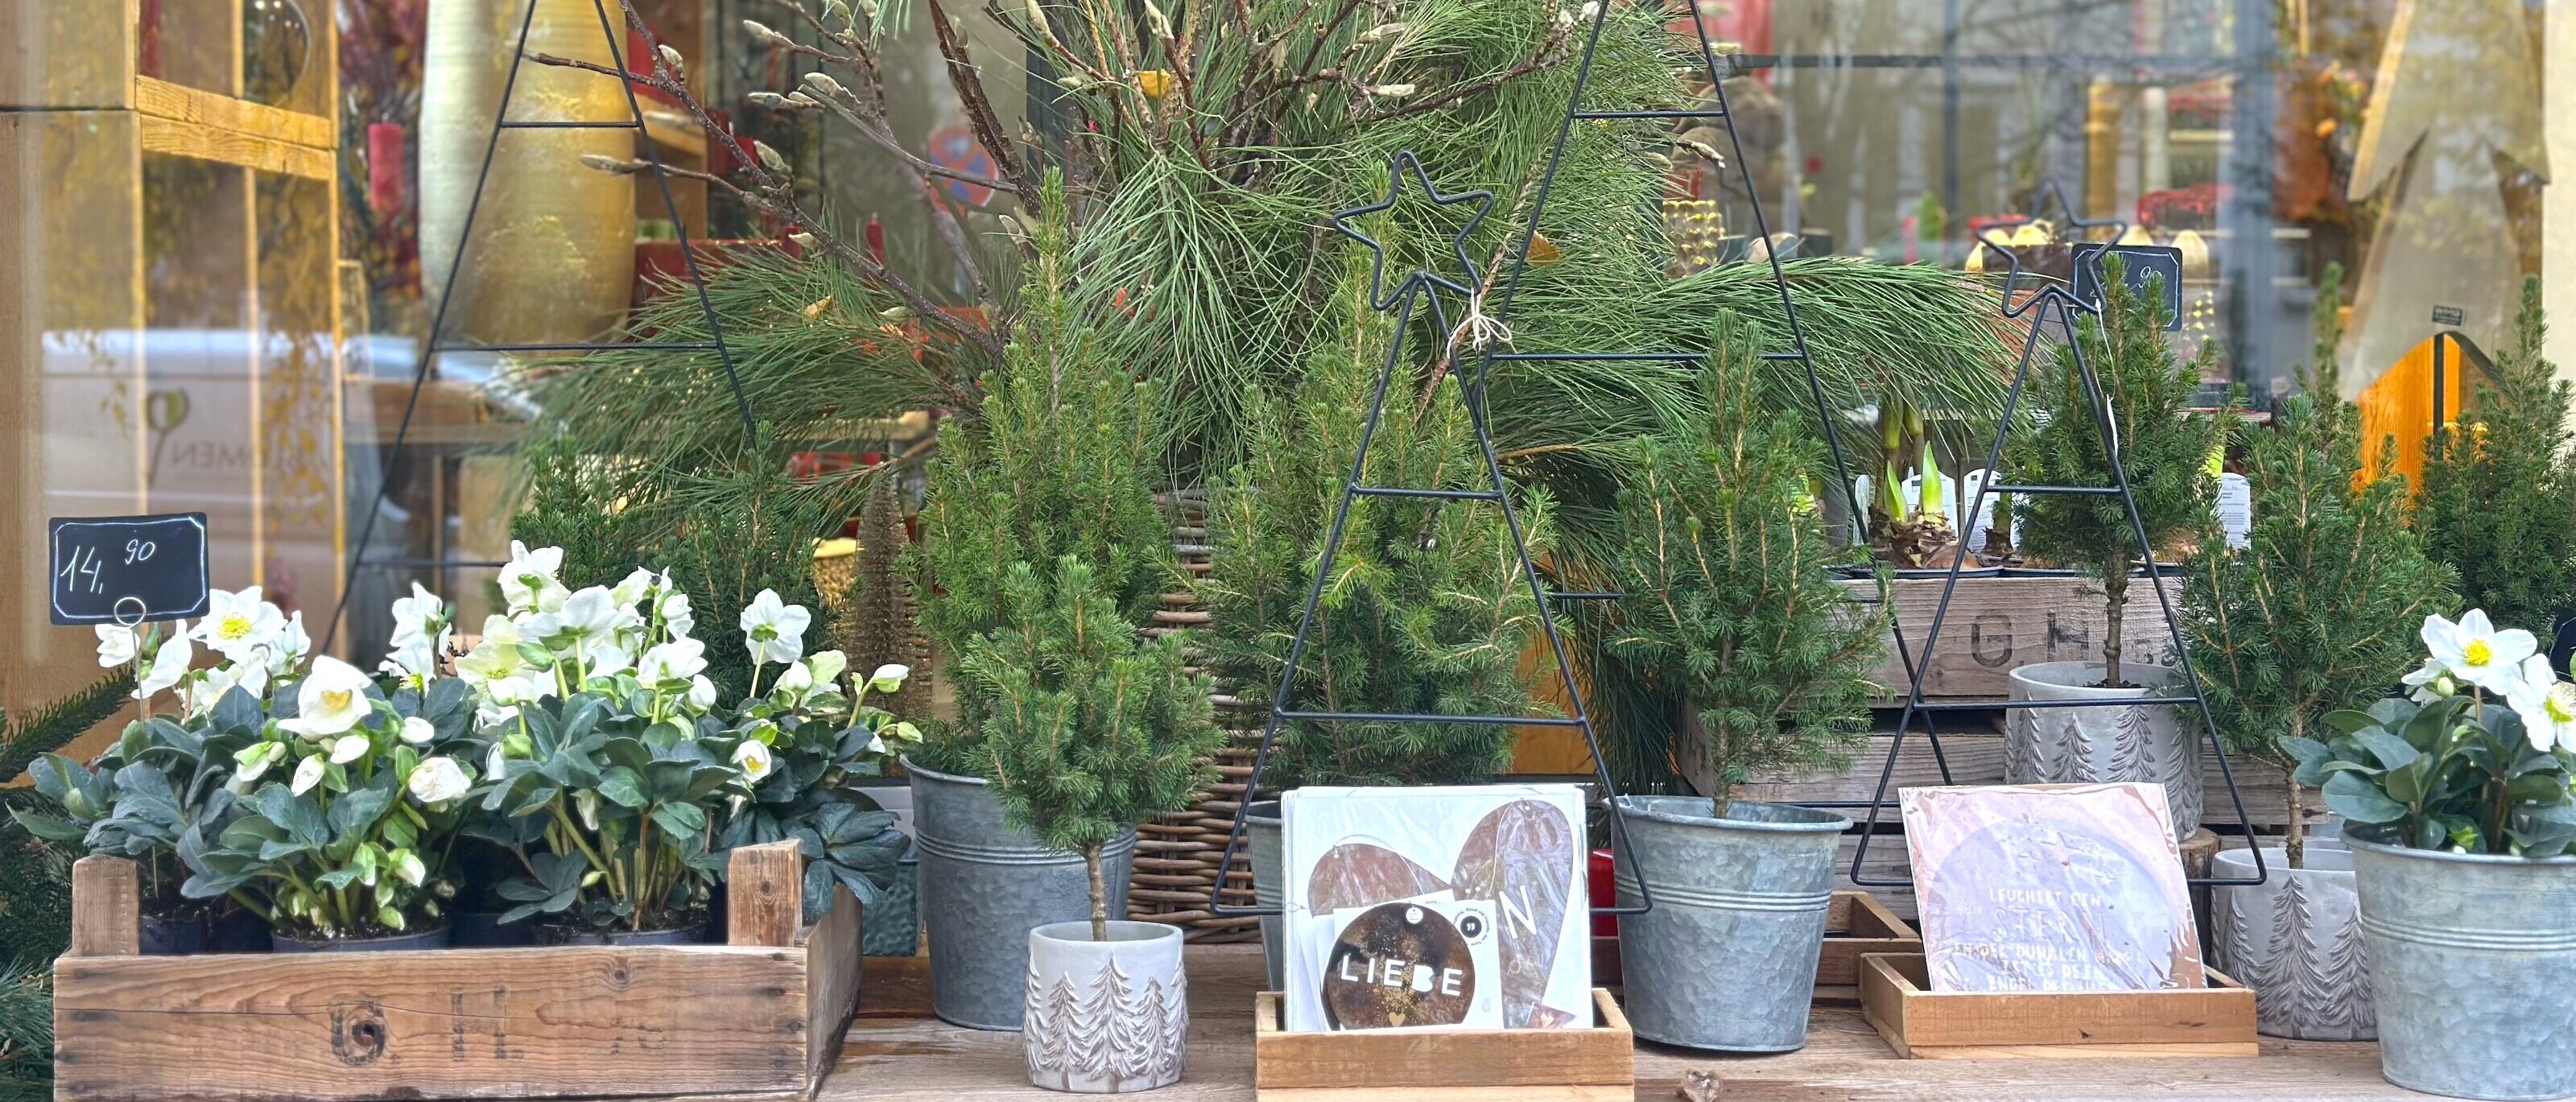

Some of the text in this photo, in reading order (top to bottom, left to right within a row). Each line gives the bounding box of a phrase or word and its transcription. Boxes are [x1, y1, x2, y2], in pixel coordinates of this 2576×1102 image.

[125, 539, 156, 565] 90
[1499, 885, 1538, 939] N
[1340, 953, 1463, 997] LIEBE
